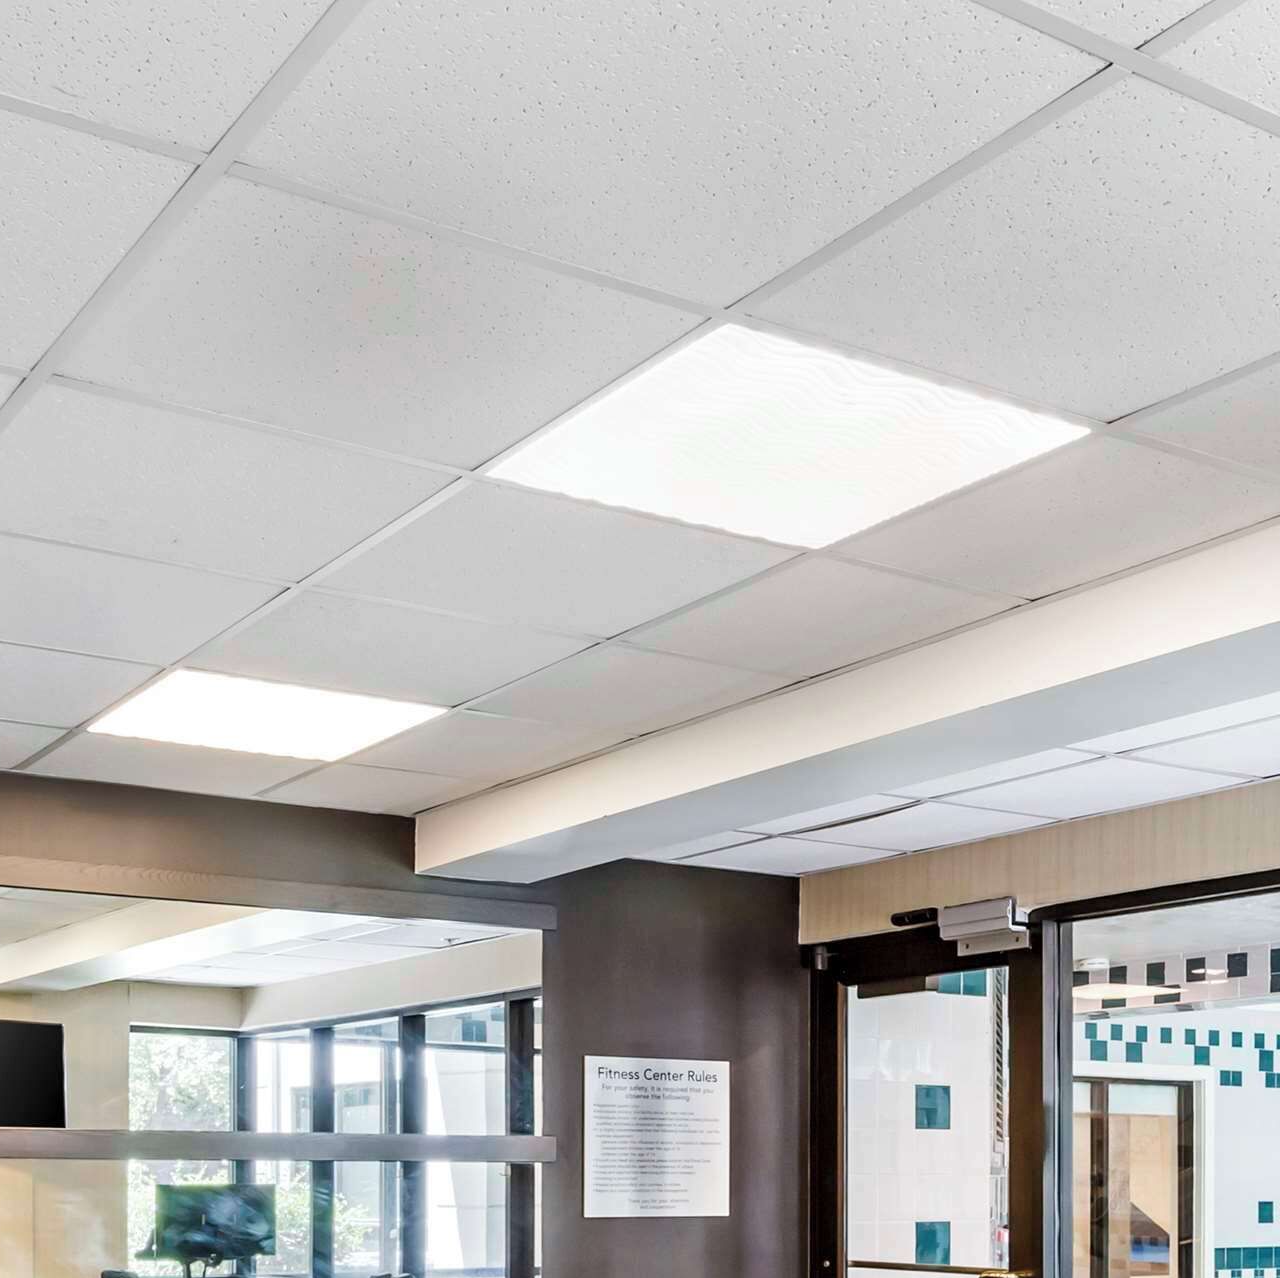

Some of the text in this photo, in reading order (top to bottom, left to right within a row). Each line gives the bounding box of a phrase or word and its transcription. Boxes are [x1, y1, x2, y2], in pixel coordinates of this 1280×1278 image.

[597, 1066, 718, 1083] Fitness Center Rules
